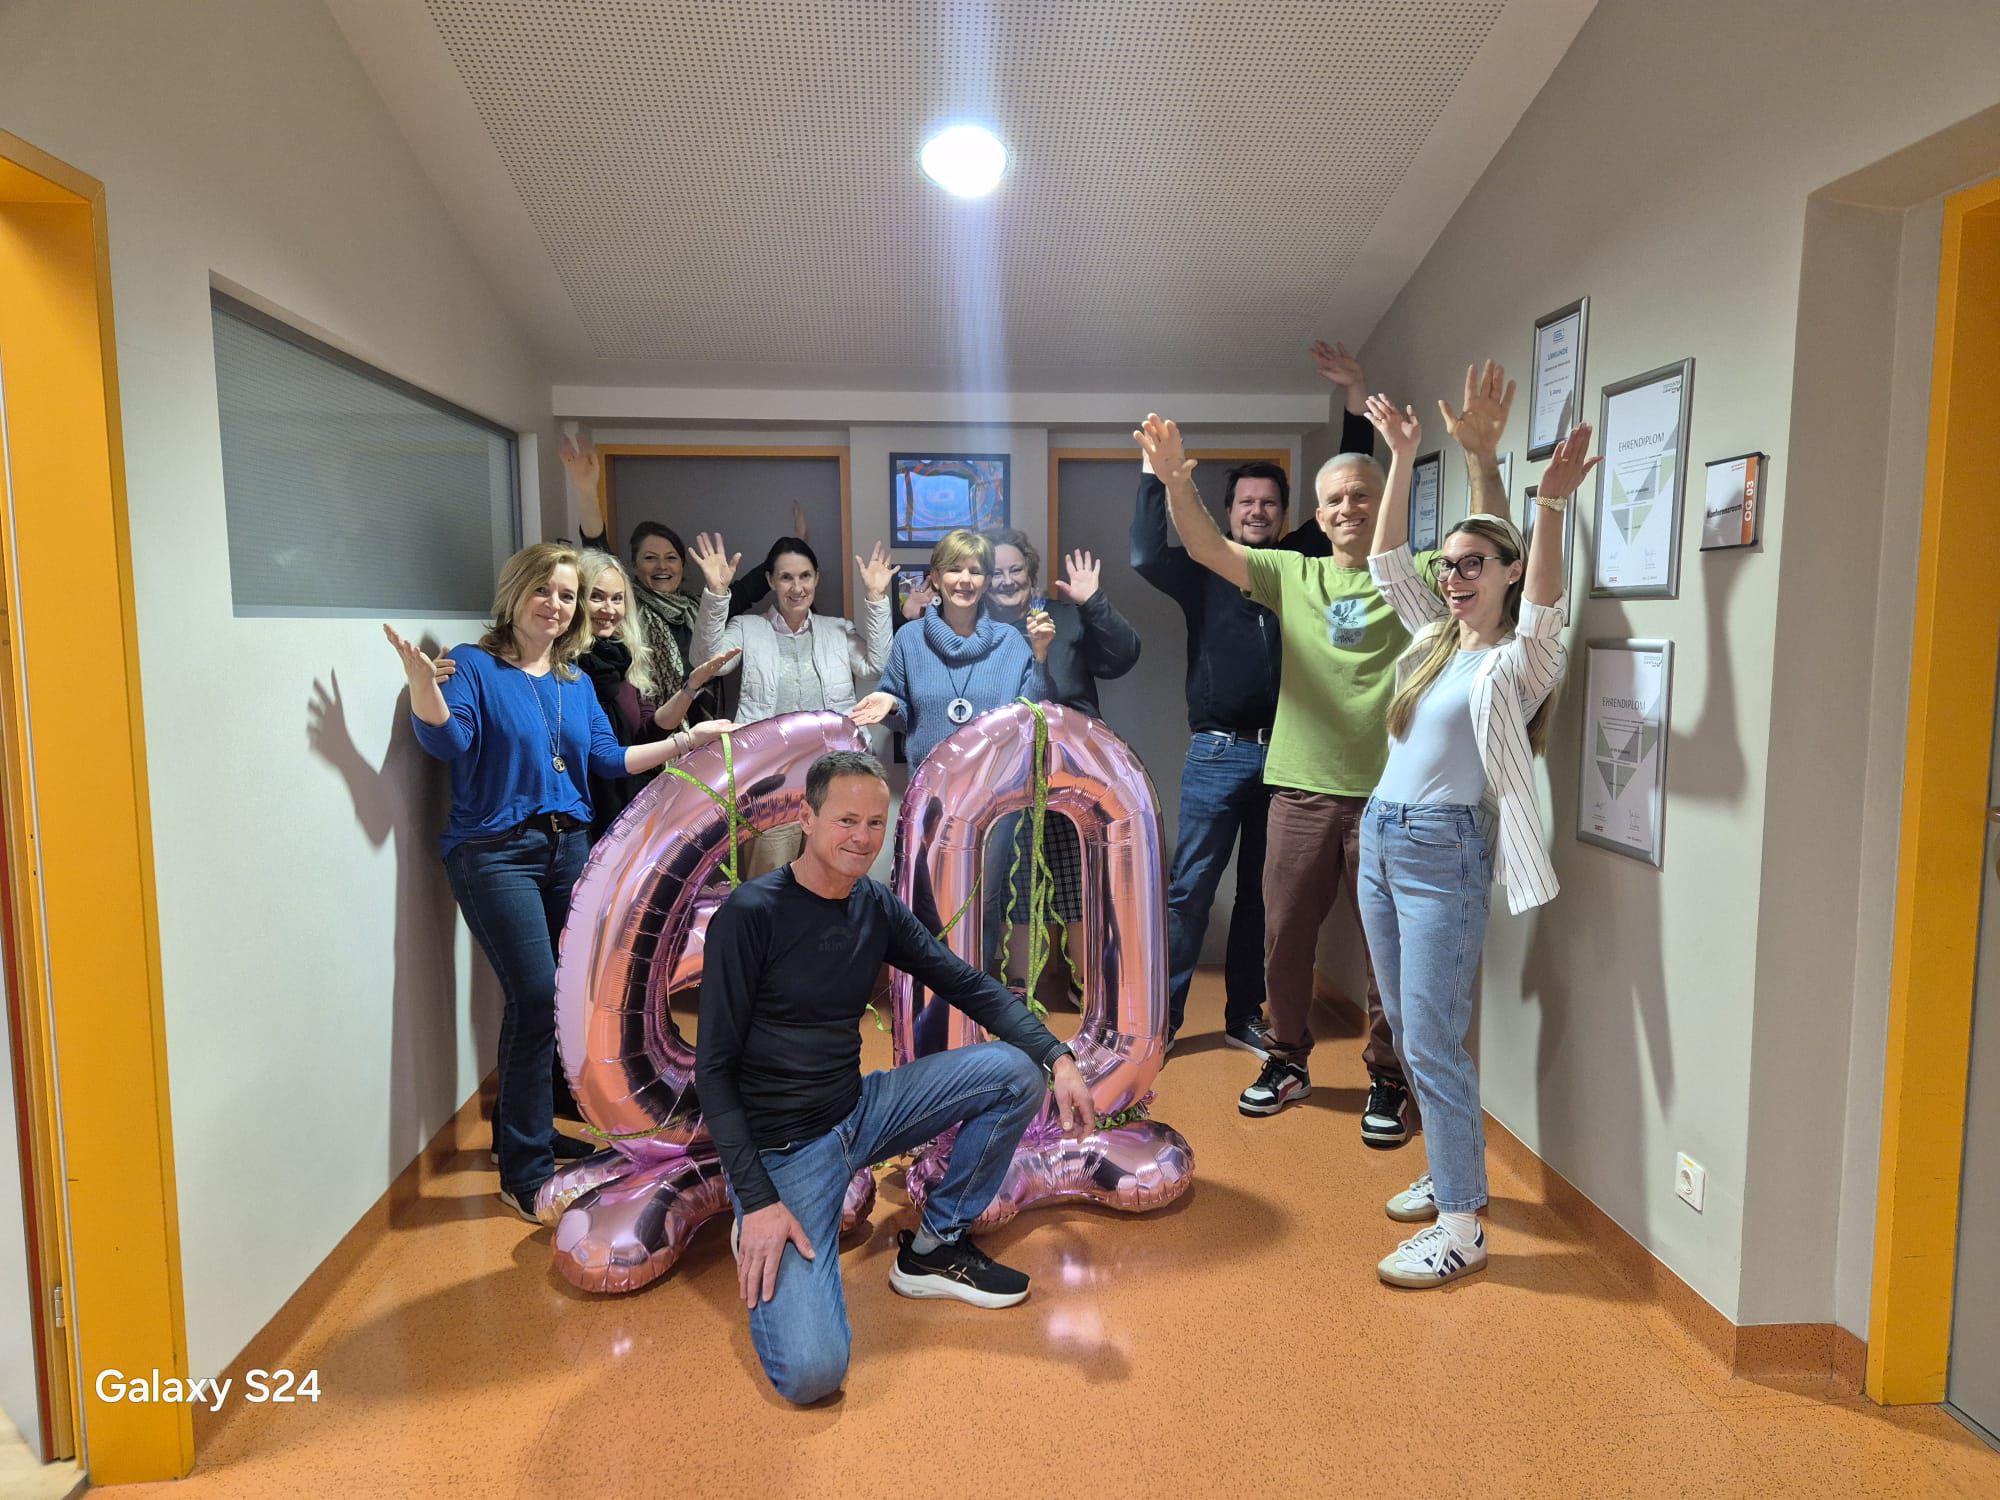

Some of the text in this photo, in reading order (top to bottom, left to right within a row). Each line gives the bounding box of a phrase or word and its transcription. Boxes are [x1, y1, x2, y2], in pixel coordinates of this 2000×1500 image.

[1618, 432, 1665, 453] EHRENDIPLOM
[1744, 480, 1754, 522] OG 03
[1602, 696, 1646, 711] EHRENDIPLOM
